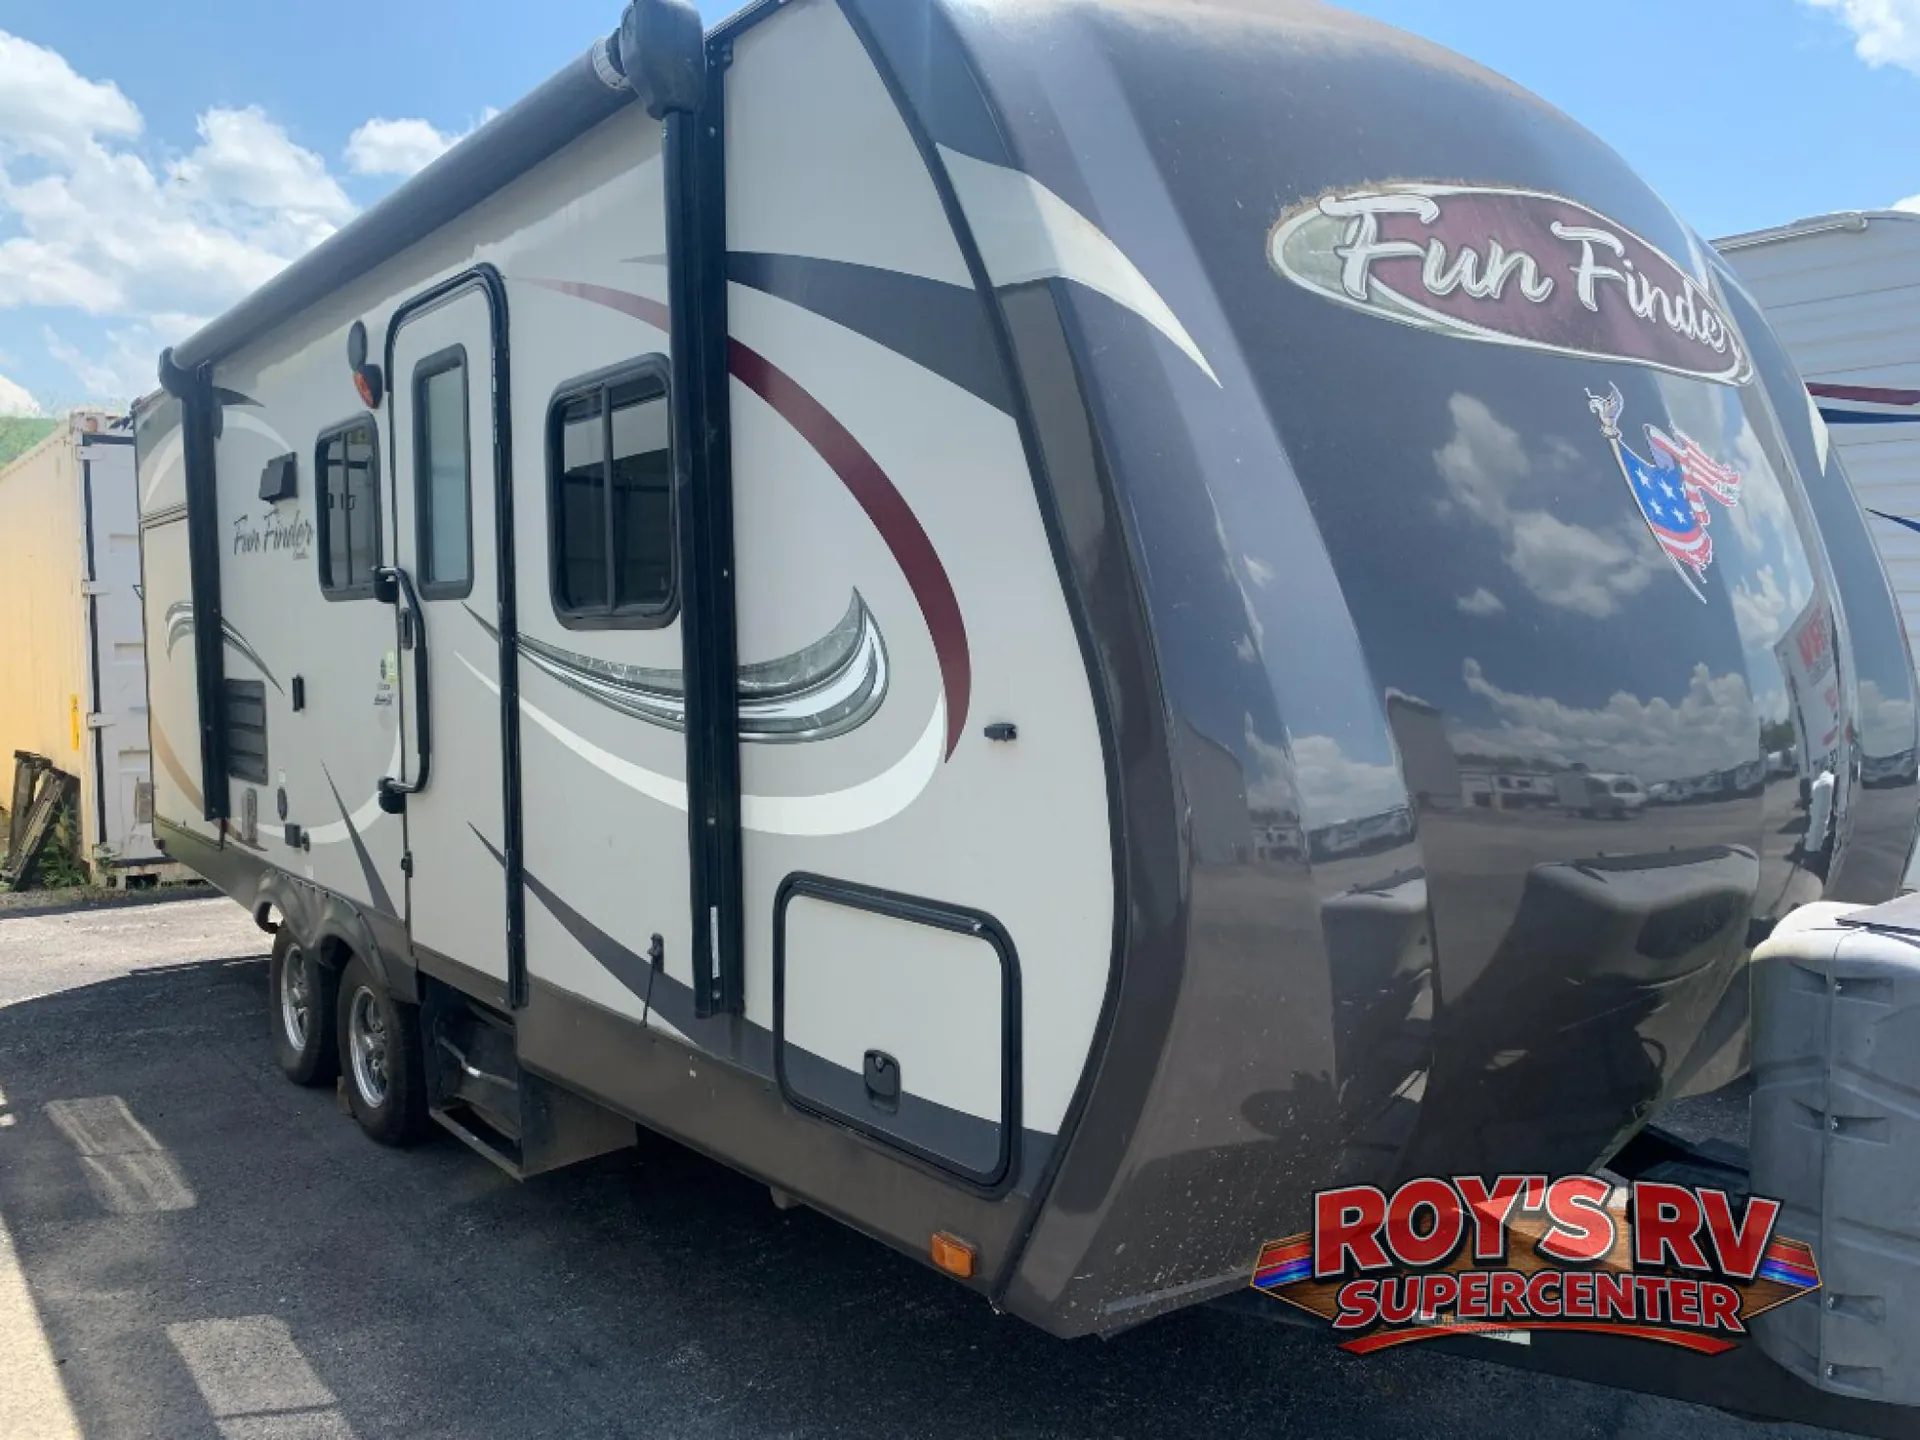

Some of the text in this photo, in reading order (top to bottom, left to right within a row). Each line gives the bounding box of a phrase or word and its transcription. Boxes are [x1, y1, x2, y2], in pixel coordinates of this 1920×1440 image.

[1318, 195, 1554, 303] Fun
[234, 508, 315, 556] Fun Finder
